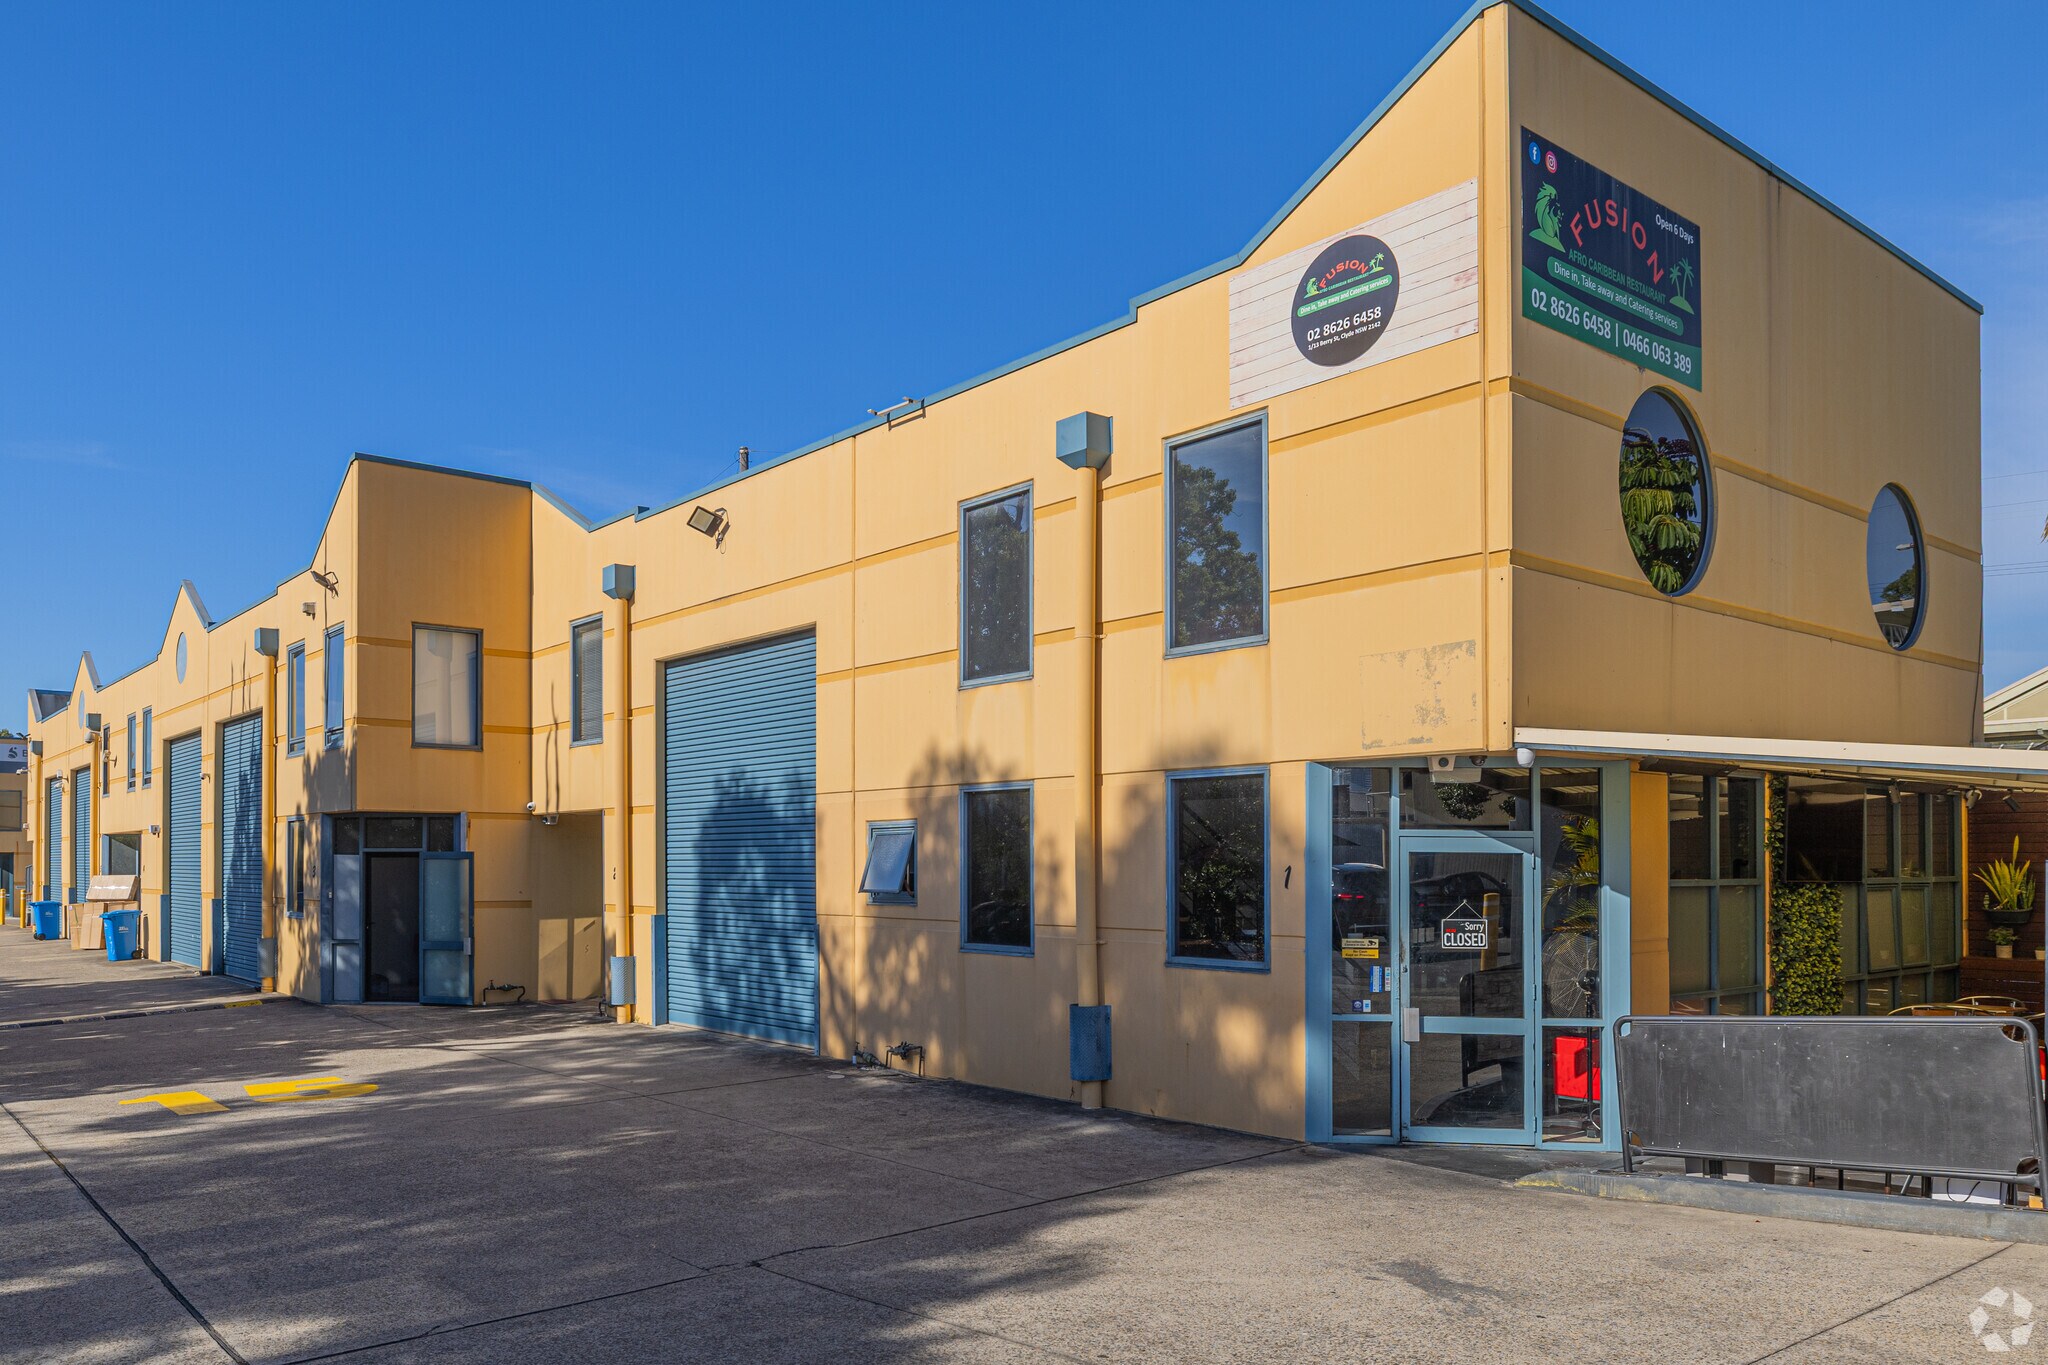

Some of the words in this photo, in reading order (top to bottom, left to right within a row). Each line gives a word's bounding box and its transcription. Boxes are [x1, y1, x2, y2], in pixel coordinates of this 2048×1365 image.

[1569, 199, 1665, 285] FUSION
[1655, 214, 1673, 233] Open
[1674, 224, 1679, 235] 6
[1679, 226, 1694, 245] Days
[1319, 259, 1369, 289] FUSION
[1569, 249, 1588, 268] AFRO
[1588, 257, 1626, 286] CARIBBEAN
[1626, 275, 1666, 305] RESTAURANT
[1554, 261, 1570, 279] Dine
[1571, 269, 1580, 286] in,
[1581, 274, 1597, 291] Take
[1597, 284, 1615, 302] away
[1615, 293, 1628, 306] and
[1628, 297, 1654, 320] Catering
[1654, 312, 1678, 330] services
[1307, 327, 1321, 342] 02
[1323, 317, 1350, 337] 8626
[1353, 306, 1382, 326] 6458
[1531, 287, 1547, 313] 02
[1550, 296, 1580, 326] 8626
[1583, 310, 1612, 339] 6458
[1623, 328, 1650, 356] 0466
[1652, 341, 1671, 366] 063
[1674, 351, 1692, 375] 389
[1284, 864, 1292, 890] 1
[1443, 932, 1486, 947] CLOSED
[1464, 921, 1484, 933] Sorry
